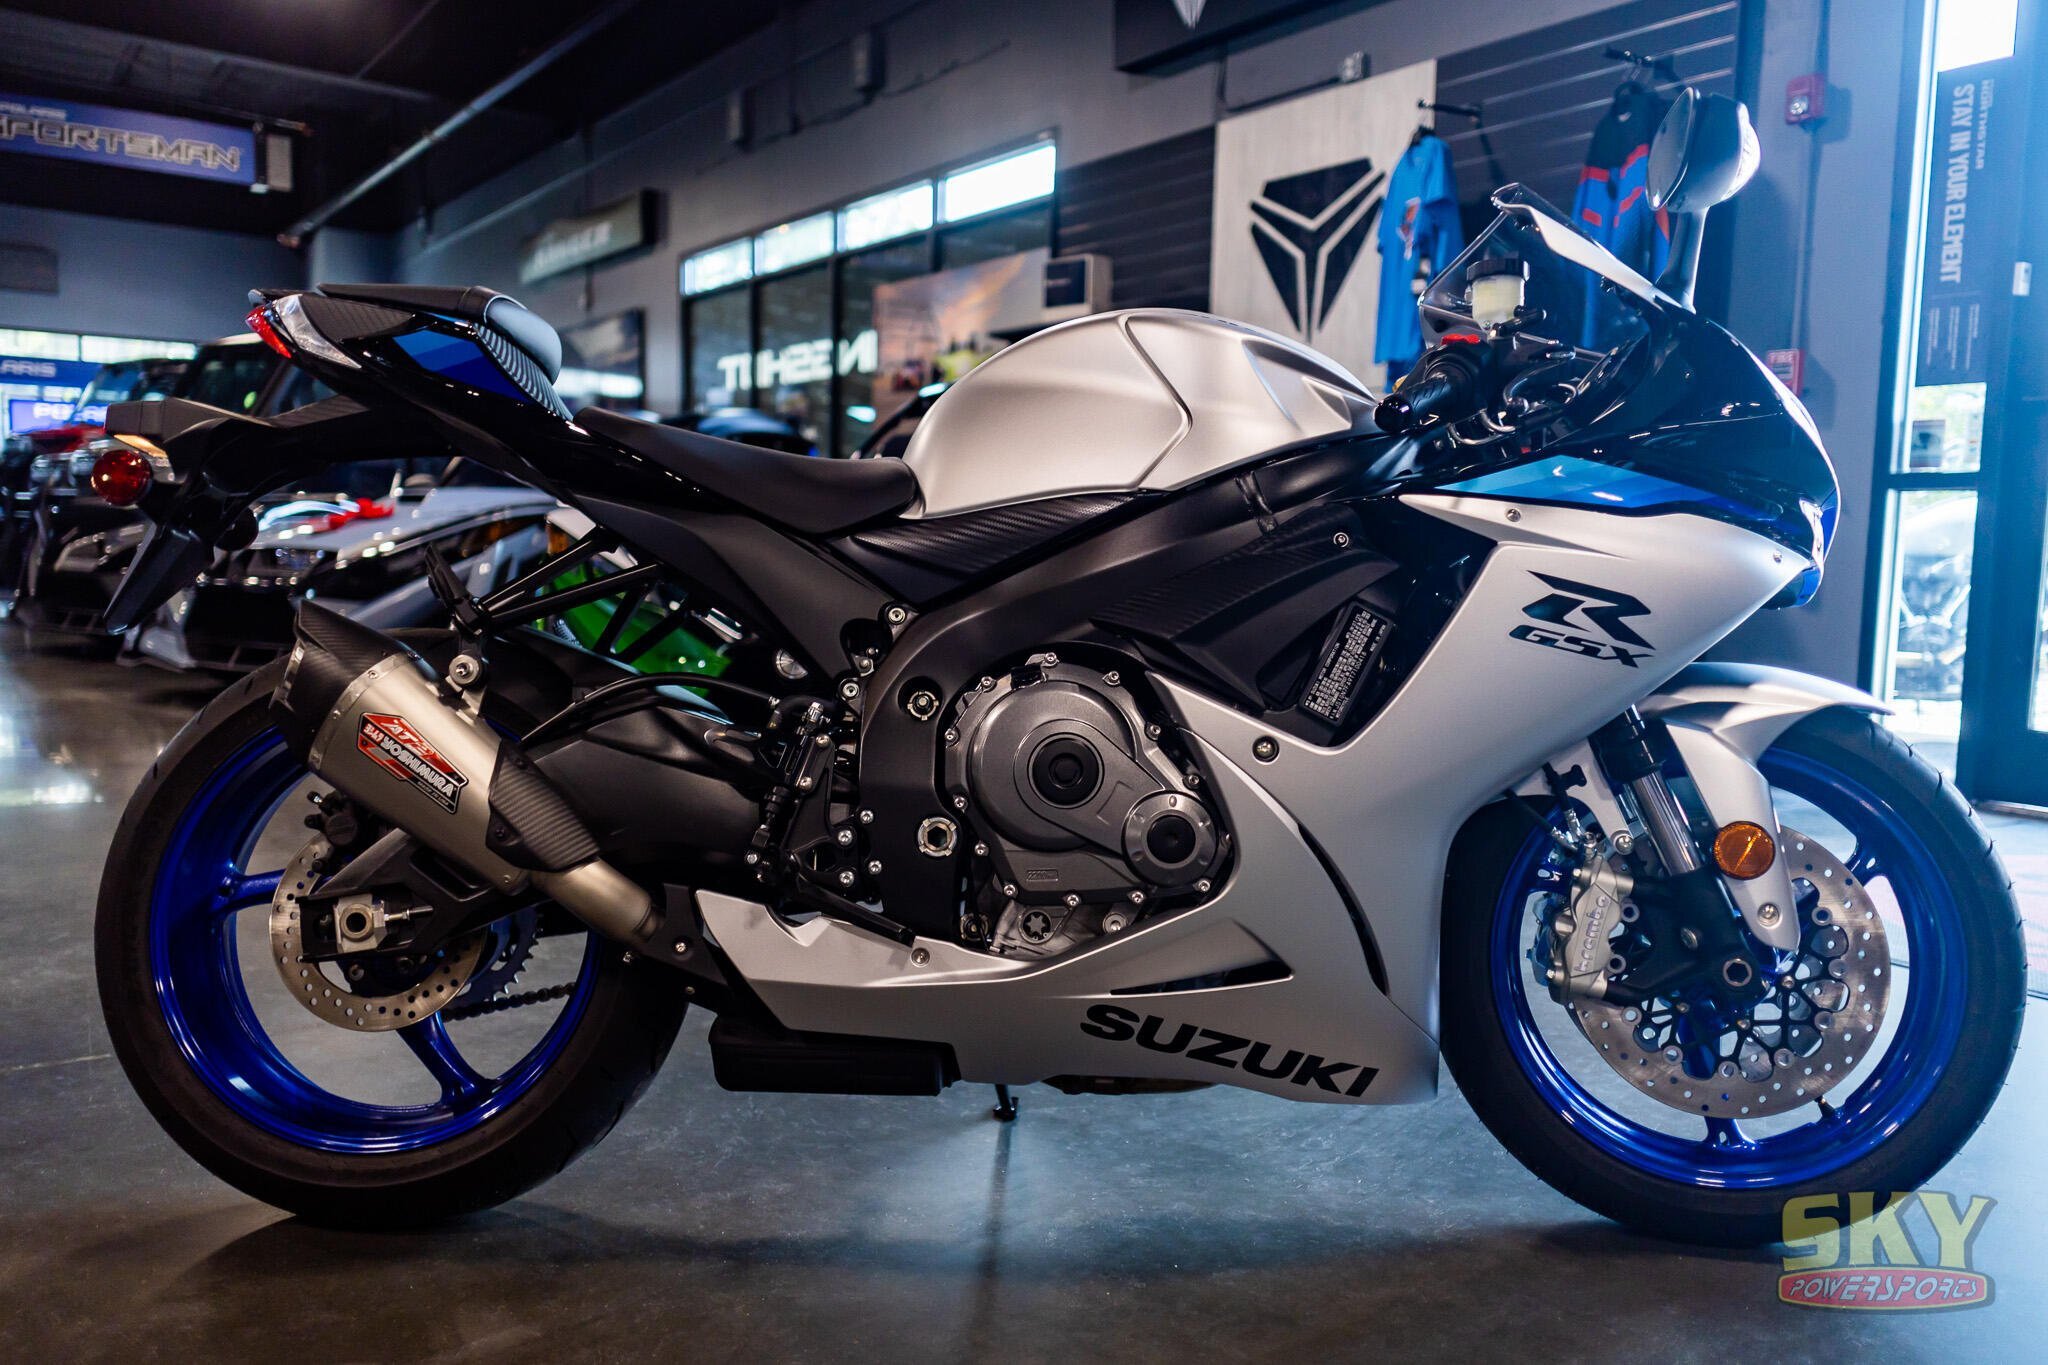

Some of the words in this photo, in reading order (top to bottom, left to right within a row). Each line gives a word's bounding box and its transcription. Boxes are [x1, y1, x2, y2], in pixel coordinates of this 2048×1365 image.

[1951, 83, 1975, 127] STAY
[1949, 131, 1971, 152] IN
[1946, 152, 1970, 202] YOUR
[1940, 203, 1966, 284] ELEMENT
[1522, 570, 1656, 650] R
[1509, 624, 1655, 668] GSX
[380, 735, 455, 798] YOSHIMURA
[1574, 895, 1611, 972] brembo
[1080, 1004, 1379, 1097] SUZUKI
